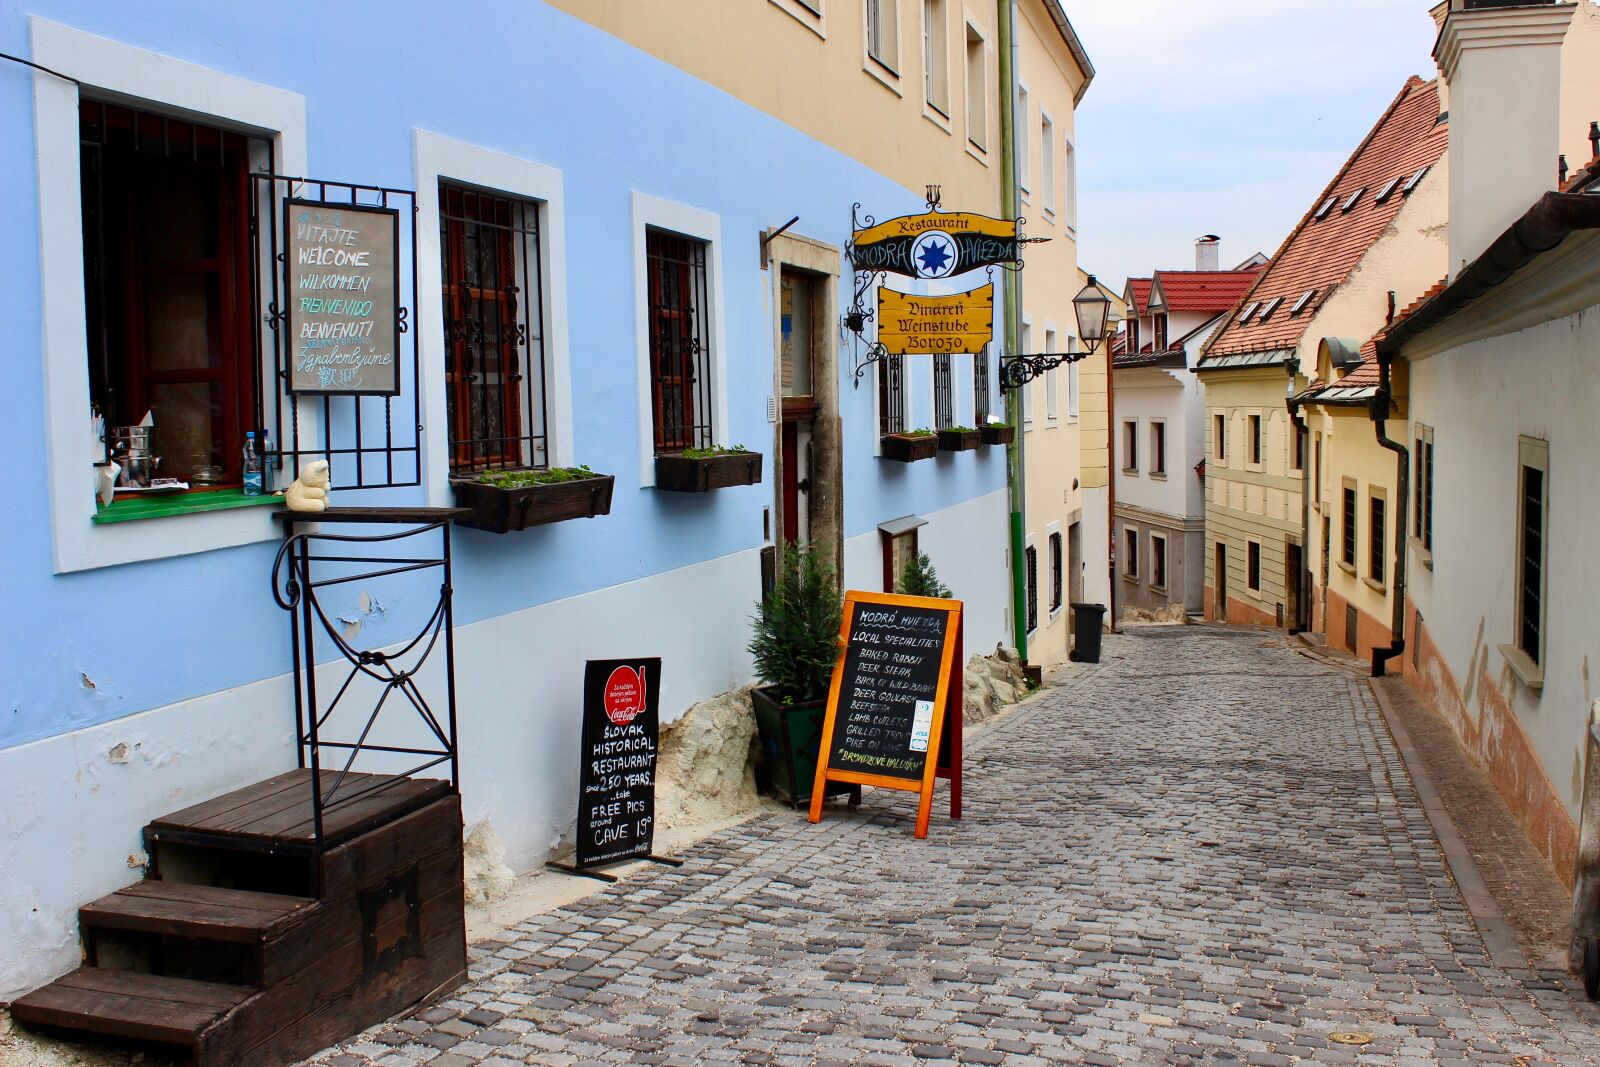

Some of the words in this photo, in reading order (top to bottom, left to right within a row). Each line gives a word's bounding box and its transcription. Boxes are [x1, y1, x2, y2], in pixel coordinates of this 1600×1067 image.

[898, 218, 970, 233] Restaurant
[297, 224, 359, 247] VITAJTE
[299, 246, 370, 267] WELCOME
[300, 273, 371, 293] WILKOMMEN
[299, 297, 372, 317] BIENVENIDO
[299, 320, 374, 339] BENVENUTI
[897, 318, 969, 332] Weinstube
[852, 631, 881, 644] LOCAL
[884, 635, 942, 648] SPECIALITIES
[859, 648, 889, 660] BAKED
[892, 652, 924, 665] RABBIT
[857, 662, 880, 673] DEER
[883, 665, 911, 678] STEAK
[854, 675, 876, 687] BACK
[853, 687, 876, 700] DEER
[878, 692, 918, 704] GOULASH
[848, 713, 871, 723] LAMB
[603, 724, 644, 739] SLOVAK
[846, 724, 881, 737] GRILLED
[593, 736, 655, 756] HISTORICAL
[845, 737, 866, 748] PIKE
[591, 752, 656, 777] RESTAURANT
[600, 774, 622, 792] 250
[591, 802, 621, 819] FREE
[626, 800, 645, 814] PICS
[590, 817, 612, 829] around
[594, 823, 629, 846] CAVE
